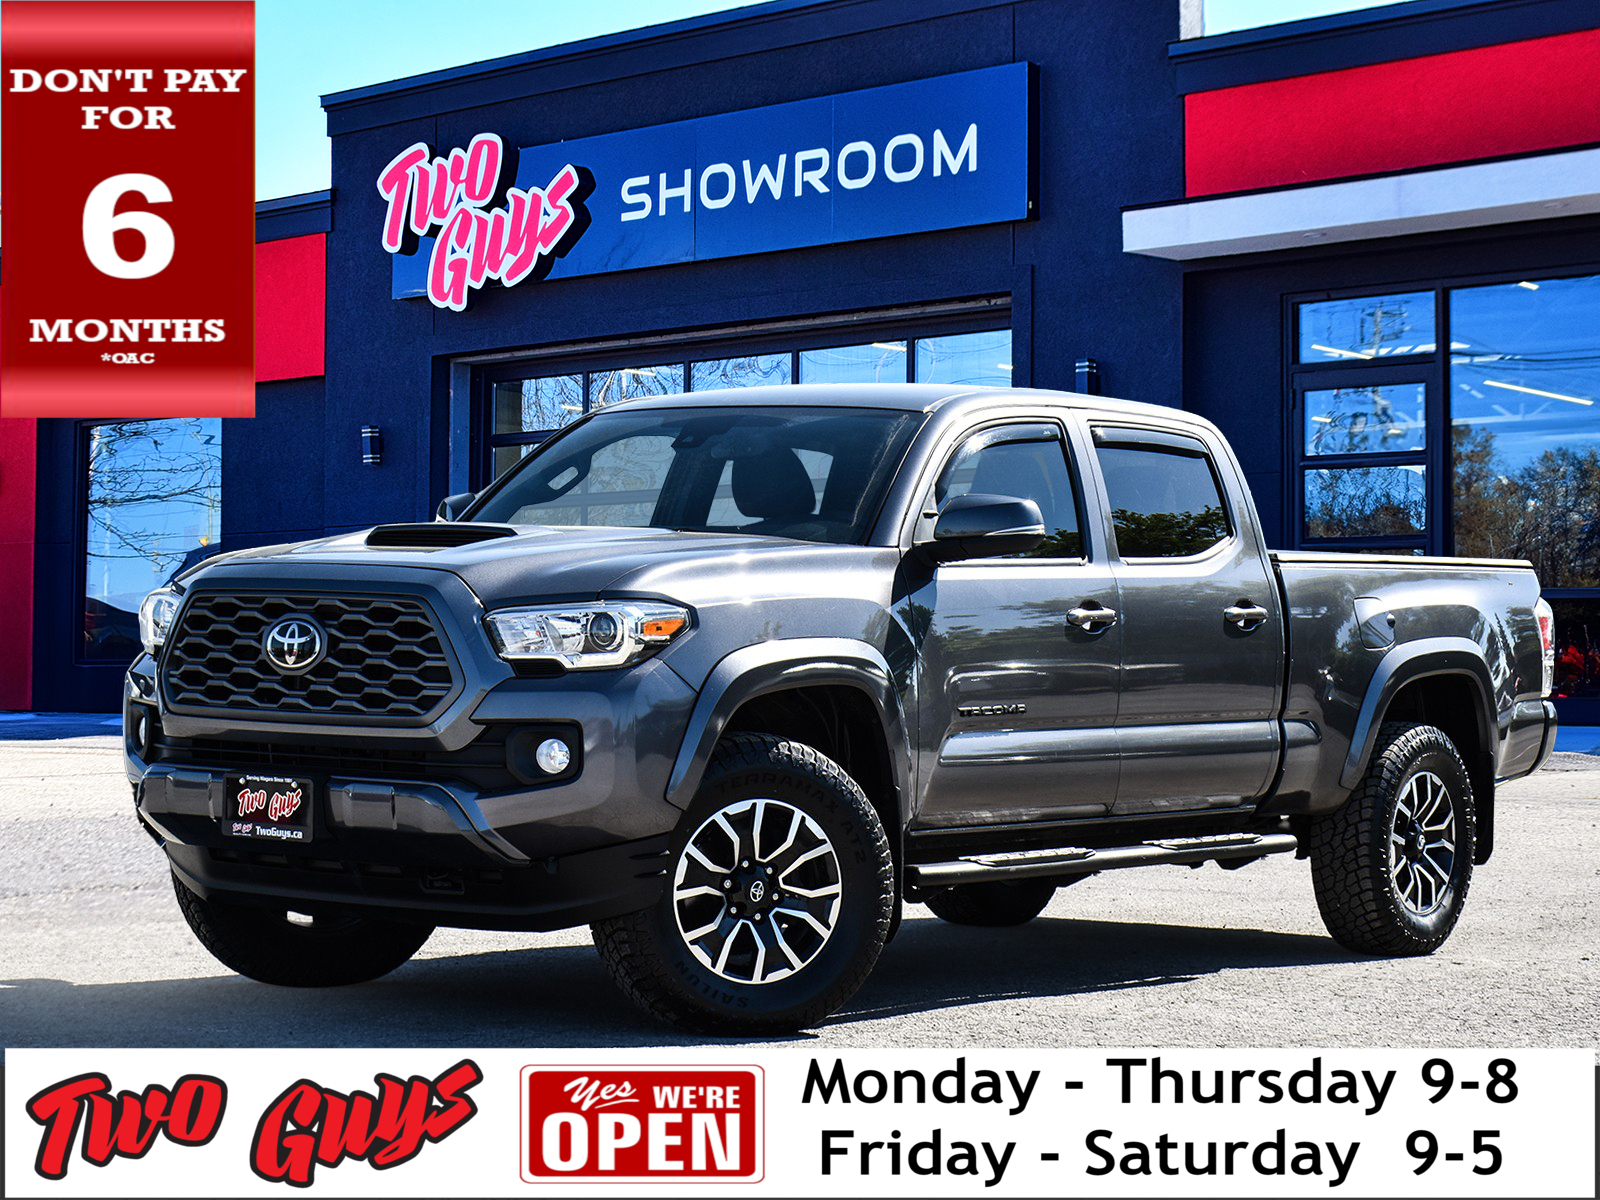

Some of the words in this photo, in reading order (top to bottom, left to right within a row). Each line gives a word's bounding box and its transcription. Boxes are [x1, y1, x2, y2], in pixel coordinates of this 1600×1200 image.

[620, 123, 978, 222] SHOWROOM
[714, 772, 839, 815] TERRAMAX
[255, 826, 303, 839] TwoGuys.ca
[674, 958, 750, 1009] SAILUN
